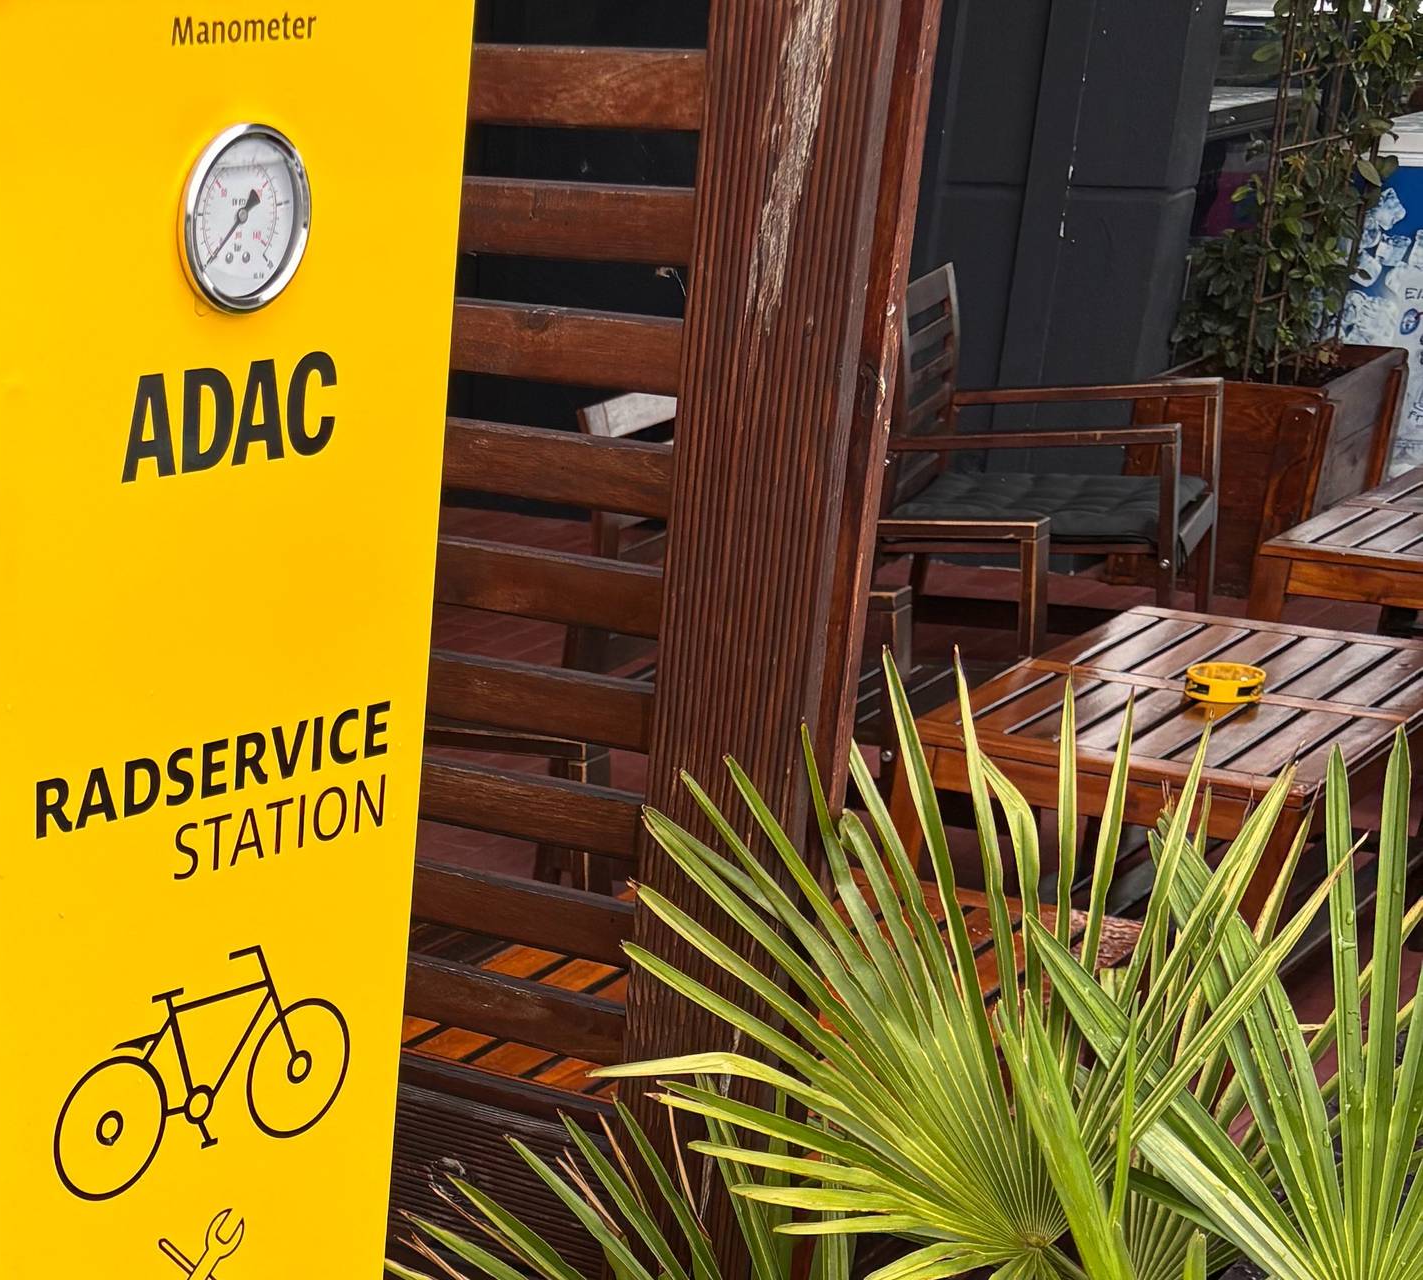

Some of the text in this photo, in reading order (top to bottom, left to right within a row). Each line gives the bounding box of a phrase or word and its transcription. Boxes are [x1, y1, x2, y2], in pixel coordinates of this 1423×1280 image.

[171, 11, 317, 46] Manometer
[121, 350, 337, 483] ADAC
[35, 700, 392, 839] RADSERVICE
[173, 774, 387, 880] STATION
